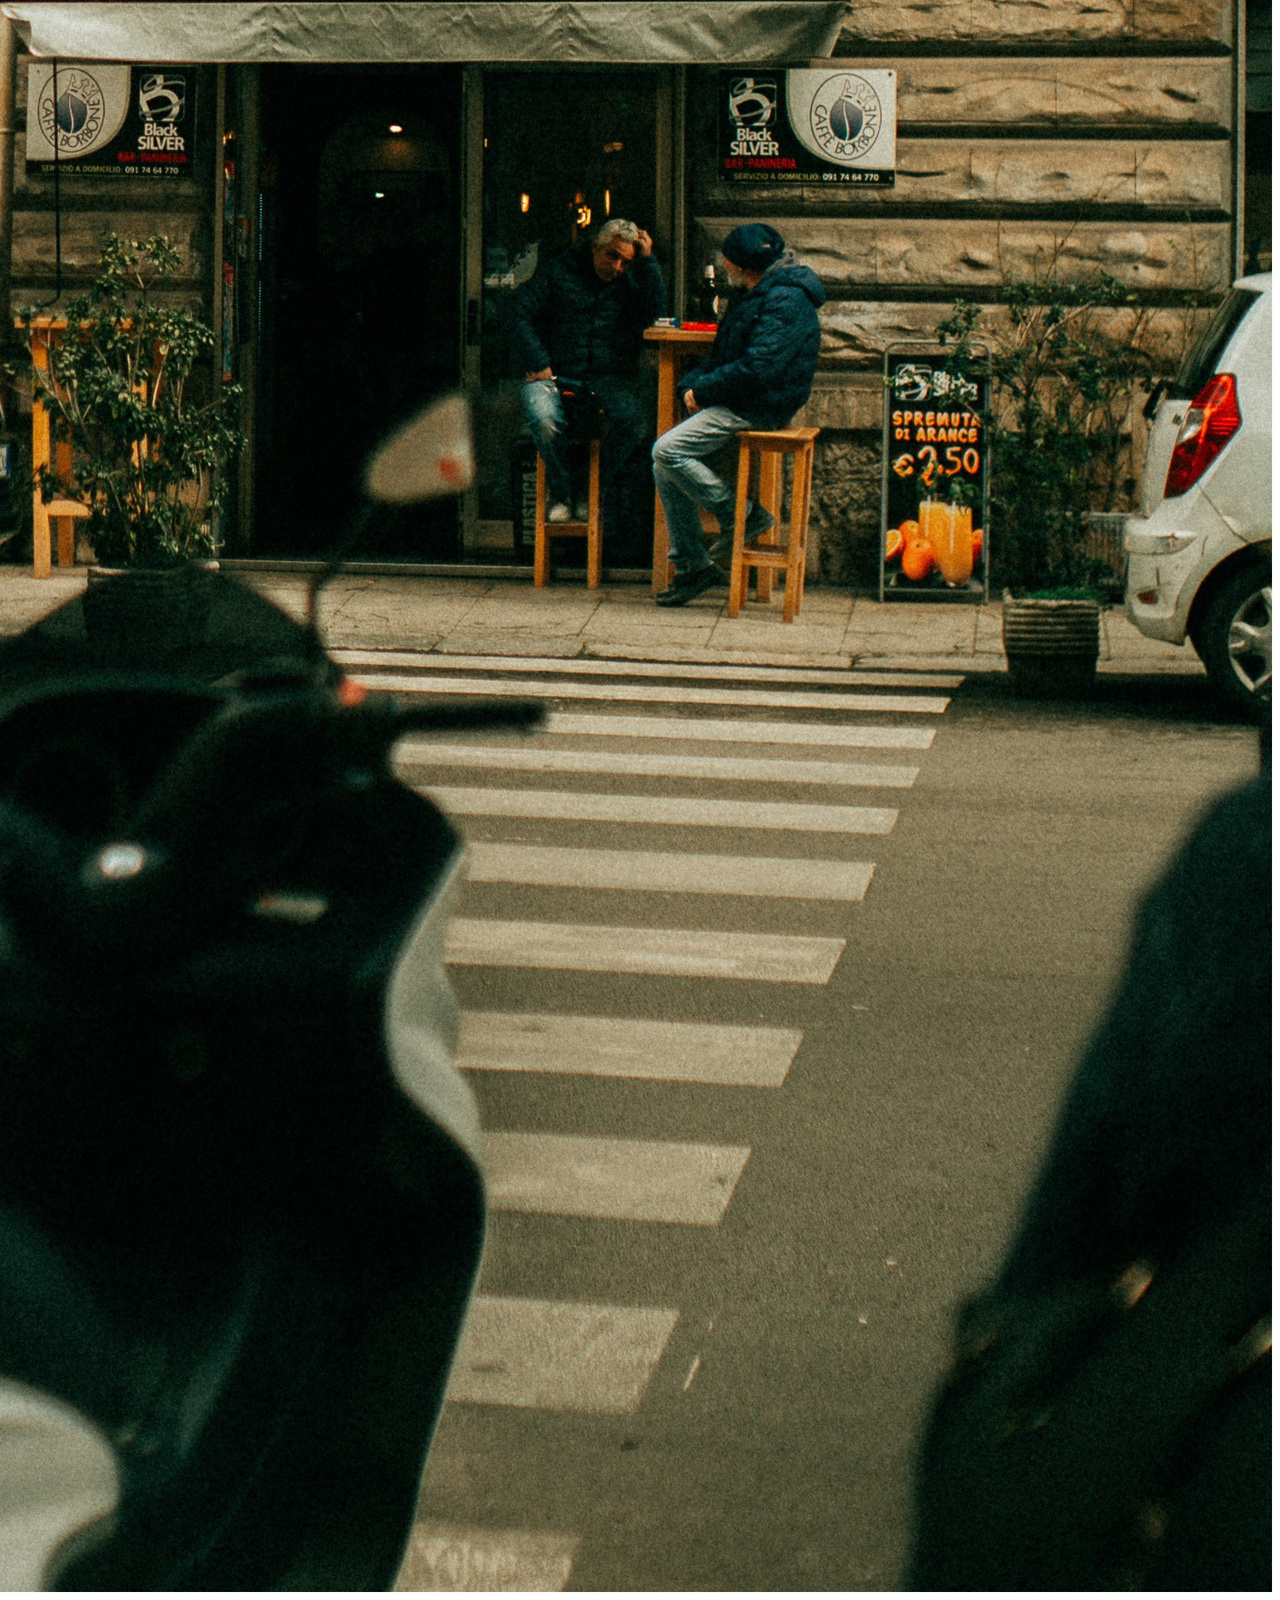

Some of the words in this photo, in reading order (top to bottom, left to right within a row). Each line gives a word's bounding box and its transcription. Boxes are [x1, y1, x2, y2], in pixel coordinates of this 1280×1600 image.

[60, 99, 100, 148] BORBONE
[144, 123, 178, 137] Black
[834, 105, 877, 155] BORBONE
[736, 127, 772, 141] Black
[138, 137, 185, 151] SILVER
[730, 141, 779, 156] SILVER
[41, 164, 73, 173] SERIZIO
[124, 166, 139, 174] 091
[164, 167, 179, 175] 770
[822, 173, 837, 181] 091
[840, 173, 850, 181] 74
[852, 173, 862, 181] 64
[864, 173, 879, 181] 770
[892, 410, 981, 428] SPREMUTA
[895, 428, 911, 441] DI
[916, 427, 978, 444] ARANCE
